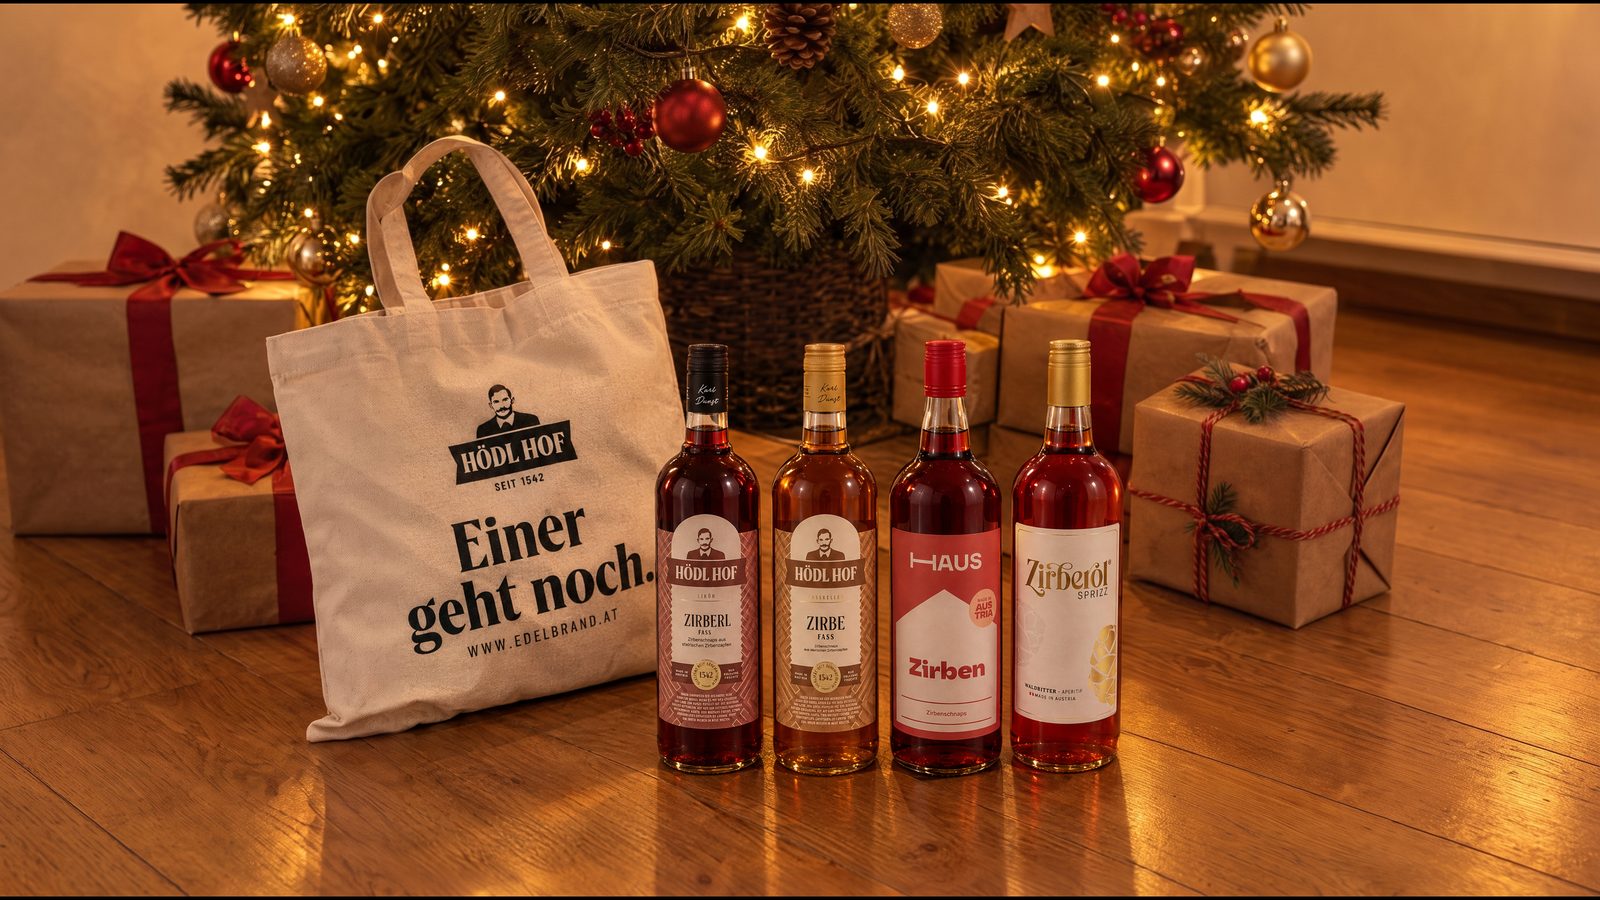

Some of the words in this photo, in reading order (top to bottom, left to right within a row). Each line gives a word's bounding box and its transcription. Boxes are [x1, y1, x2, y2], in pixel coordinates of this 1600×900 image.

[460, 444, 520, 474] HÖDL
[521, 431, 565, 460] HOF
[494, 479, 516, 491] SEIT
[520, 472, 544, 486] 1542
[451, 508, 585, 573] Einer
[909, 551, 983, 571] HAUS
[675, 563, 710, 580] HÖDL
[712, 565, 738, 580] HOF
[794, 564, 830, 582] HÖDL
[832, 566, 858, 582] HOF
[408, 575, 522, 655] geht
[530, 543, 654, 615] noch.
[1077, 587, 1108, 600] SPRIZZ
[975, 601, 993, 611] AUS
[684, 613, 731, 628] ZIRBERL
[974, 609, 994, 620] TRIA
[806, 615, 845, 631] ZIRBE
[467, 608, 619, 658] WWW.EDELBRAND.AT
[699, 671, 713, 679] 1542
[908, 656, 986, 680] Zirben
[819, 673, 833, 681] 1542
[1024, 683, 1057, 694] WALDBITTER
[926, 709, 967, 717] Zirbenschnaps
